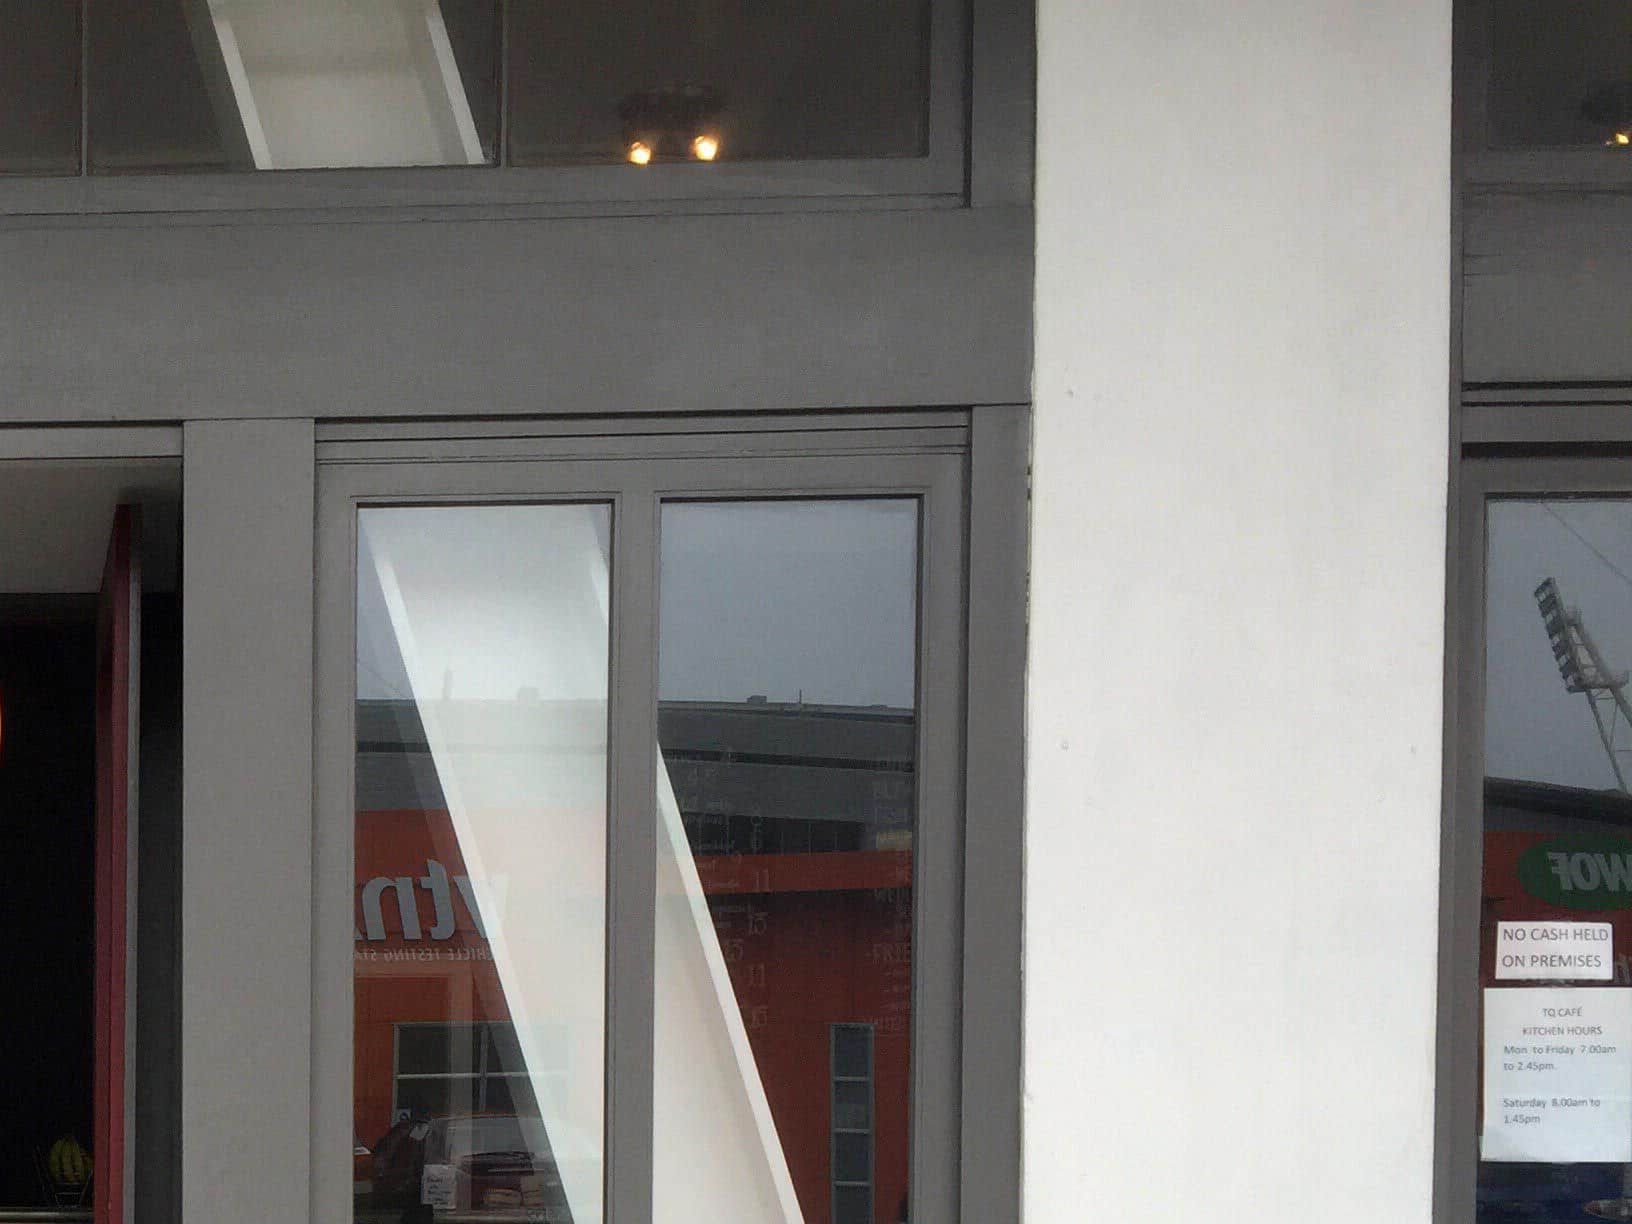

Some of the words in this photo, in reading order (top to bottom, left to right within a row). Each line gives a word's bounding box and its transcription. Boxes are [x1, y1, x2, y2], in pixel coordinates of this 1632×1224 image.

[1503, 928, 1526, 941] NO
[1530, 928, 1569, 941] CASH
[1573, 928, 1609, 941] HELD
[1502, 954, 1526, 968] ON
[1530, 954, 1602, 968] PREMISES
[1522, 1026, 1565, 1036] KITCHEN
[1567, 1026, 1603, 1036] HOURS
[1504, 1045, 1528, 1055] Mon
[1532, 1045, 1544, 1055] to
[1546, 1045, 1576, 1057] Friday
[1503, 1062, 1514, 1072] to
[1503, 1097, 1547, 1109] Saturday
[1590, 1098, 1601, 1108] to
[1503, 1114, 1541, 1126] 1.45pm
